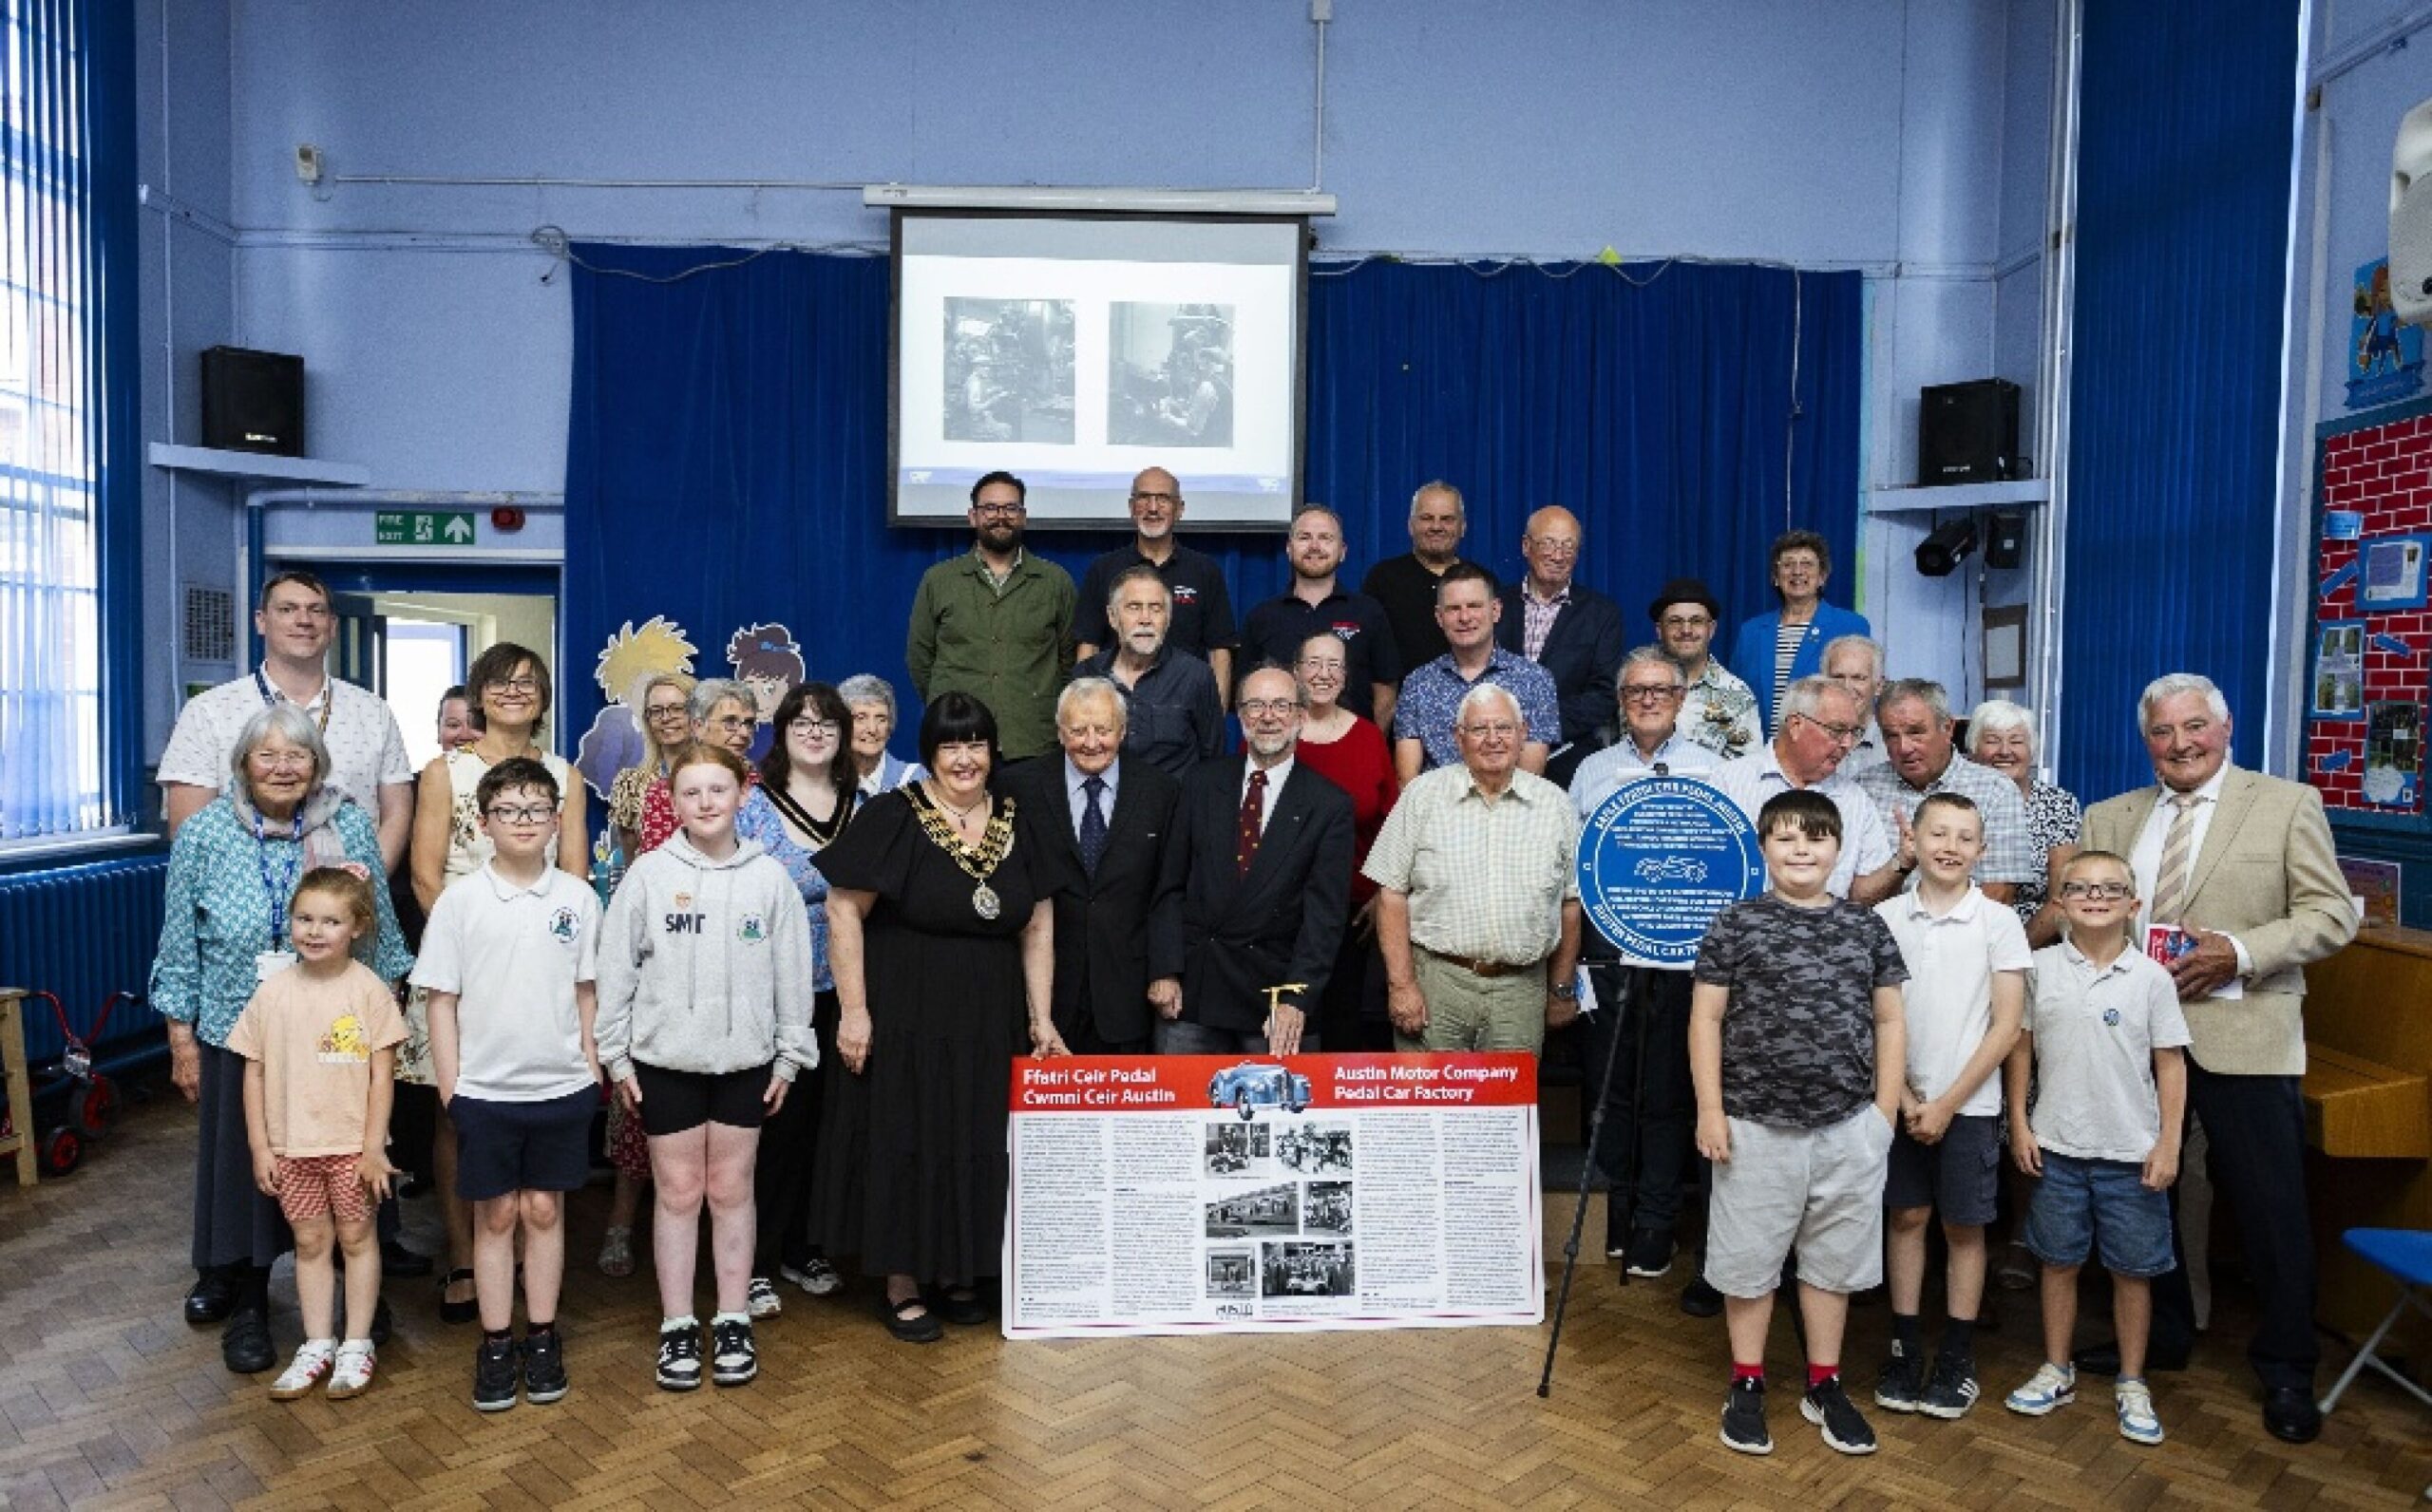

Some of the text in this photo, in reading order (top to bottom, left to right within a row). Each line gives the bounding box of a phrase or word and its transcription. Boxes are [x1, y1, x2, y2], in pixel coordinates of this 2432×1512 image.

[665, 913, 706, 934] SMT
[1023, 1067, 1156, 1085] Ffatri Ceir Pedal
[1334, 1064, 1518, 1083] Austin Motor Company
[1023, 1088, 1175, 1105] Cwmni Ceir Austin
[1334, 1086, 1474, 1102] Pedal Car Factory
